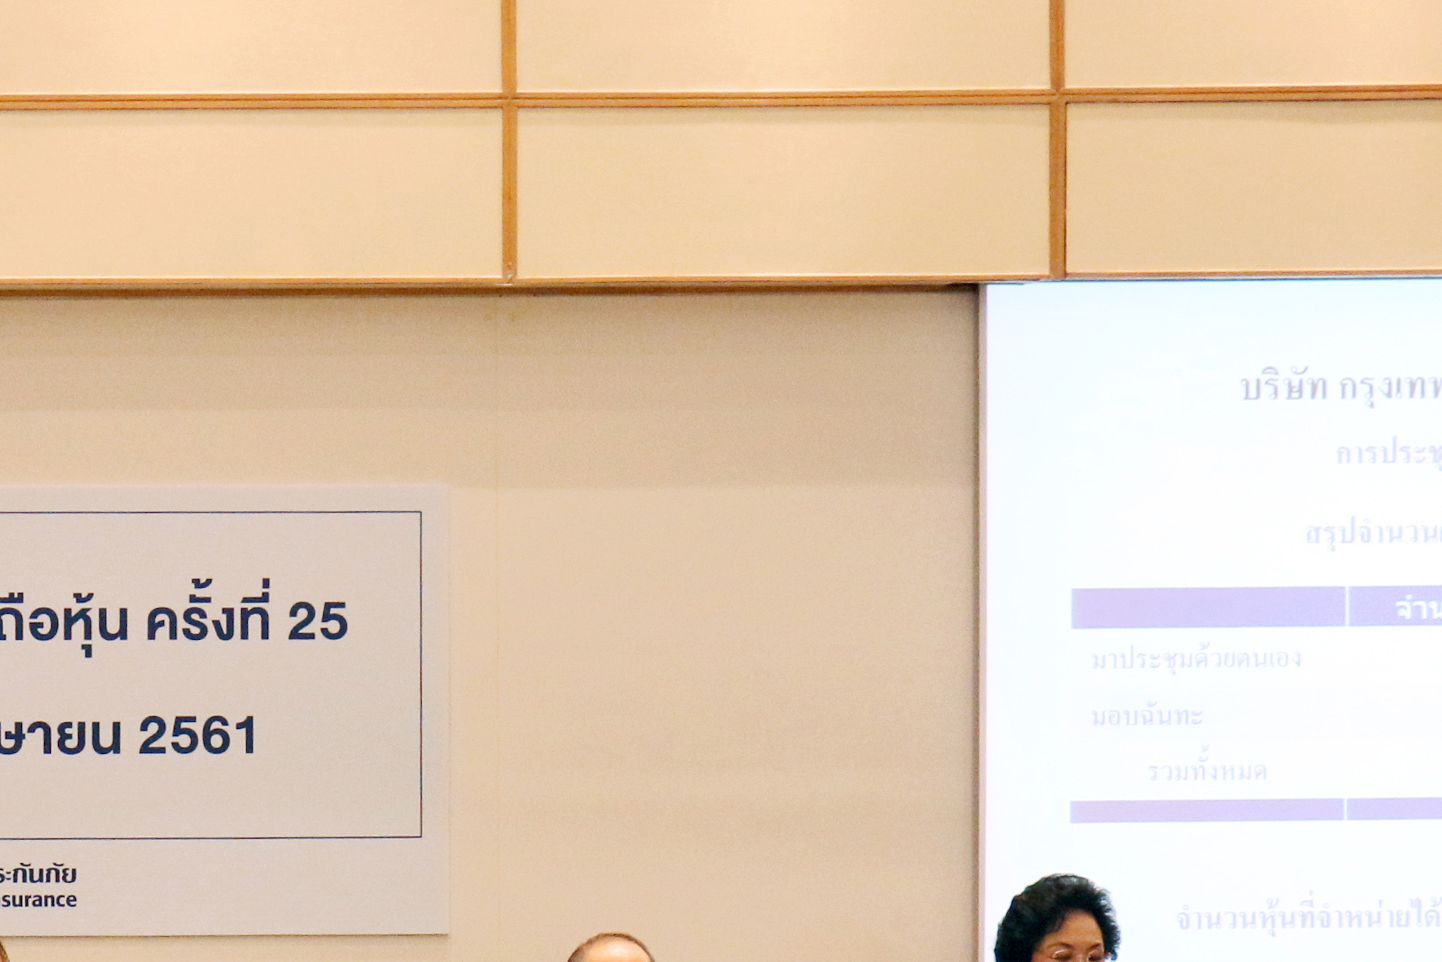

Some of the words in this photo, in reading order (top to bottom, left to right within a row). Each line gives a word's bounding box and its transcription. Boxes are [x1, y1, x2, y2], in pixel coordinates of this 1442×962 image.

[1240, 365, 1328, 401] บริษัท
[147, 577, 271, 642] ครั้งที่
[287, 601, 348, 641] 25
[1091, 641, 1302, 677] มาประชุมด้วยตนเอง
[1091, 700, 1203, 727] มอบฉันทะ
[138, 715, 254, 755] 2561
[1147, 743, 1267, 782] รวมทั้งหมด
